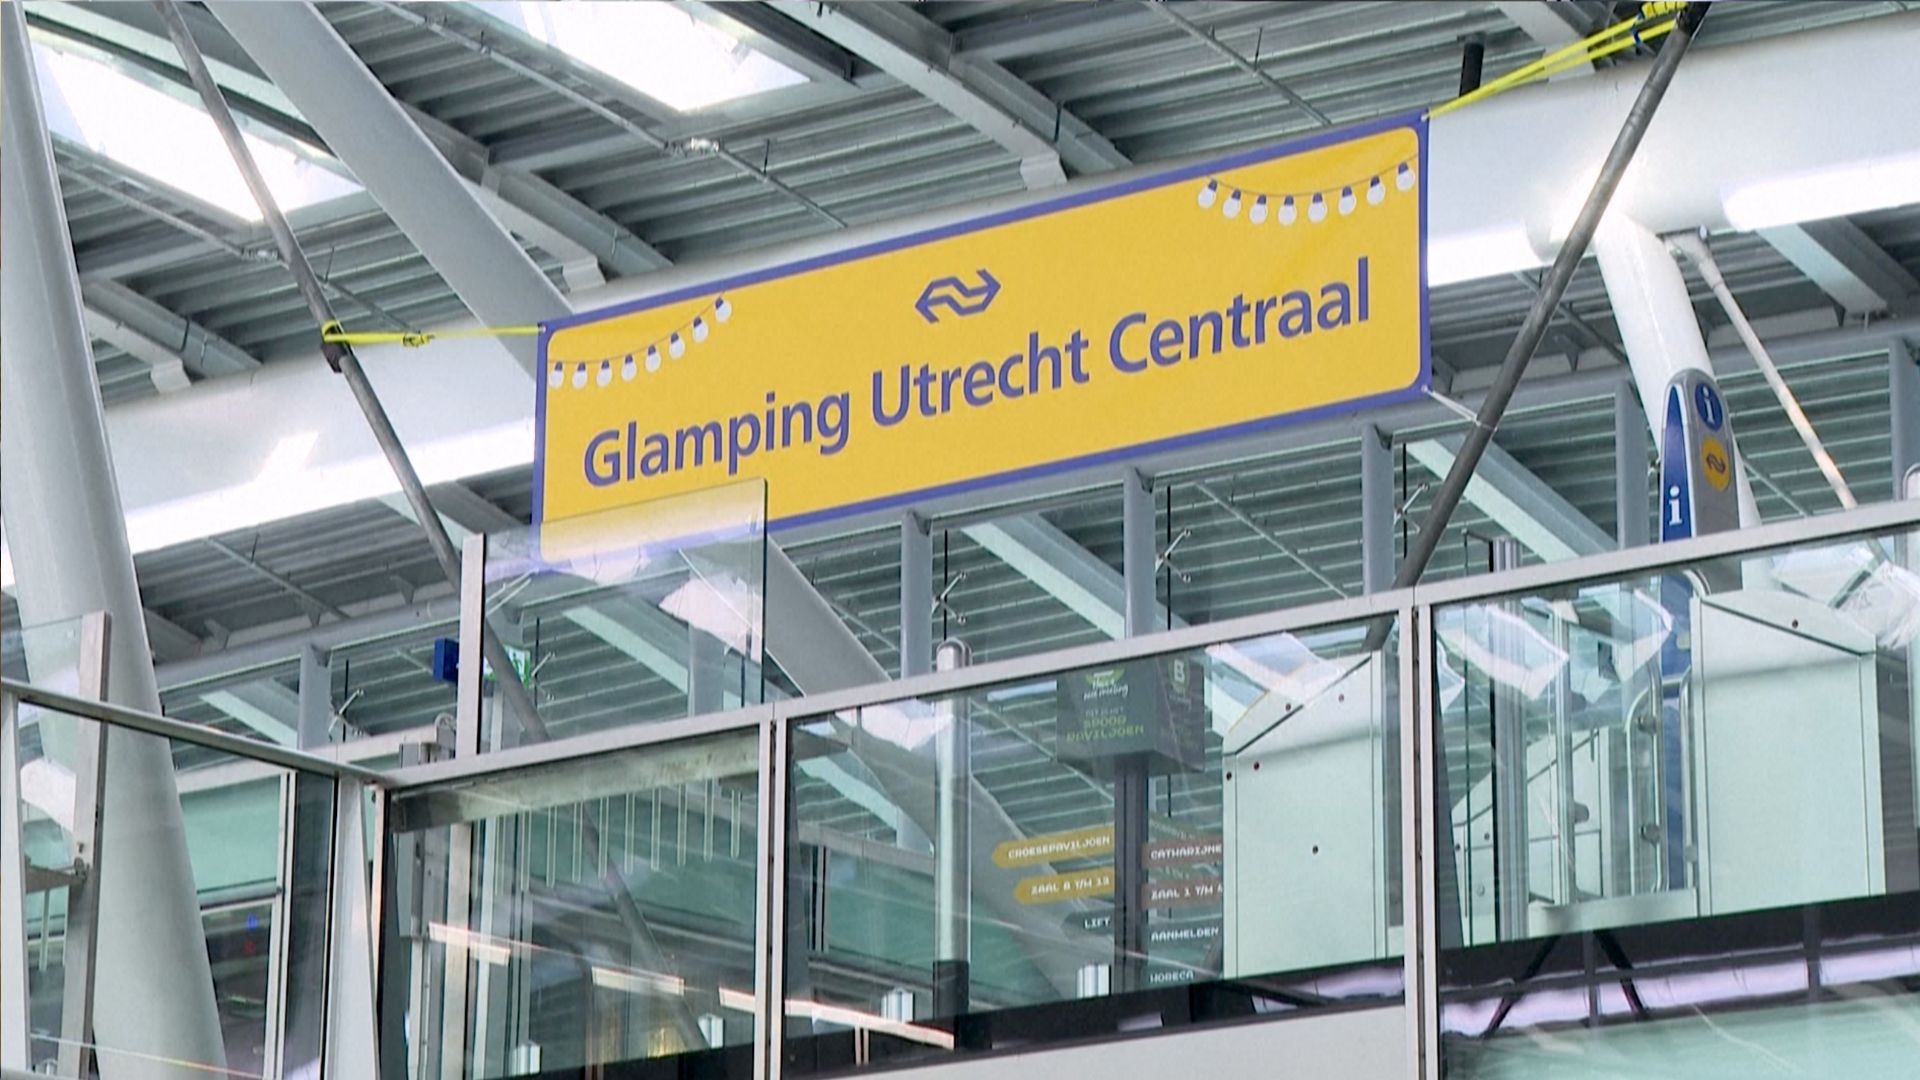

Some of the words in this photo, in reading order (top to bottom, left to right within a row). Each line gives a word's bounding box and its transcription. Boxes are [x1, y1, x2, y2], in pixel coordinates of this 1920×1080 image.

[583, 391, 851, 487] Glamping
[870, 328, 1090, 426] Utrecht
[1109, 257, 1371, 374] Centraal
[1066, 725, 1145, 743] PAVILJOEN
[1008, 835, 1110, 859] CROESEPAVILJOEN
[1031, 883, 1059, 896] ZAAL
[1075, 878, 1092, 889] T/M
[1151, 888, 1180, 899] ZAAL
[1195, 884, 1214, 896] T/M
[1084, 915, 1111, 929] LIFT
[1151, 926, 1219, 943] AANMELDEN
[1150, 971, 1194, 984] HORECA
